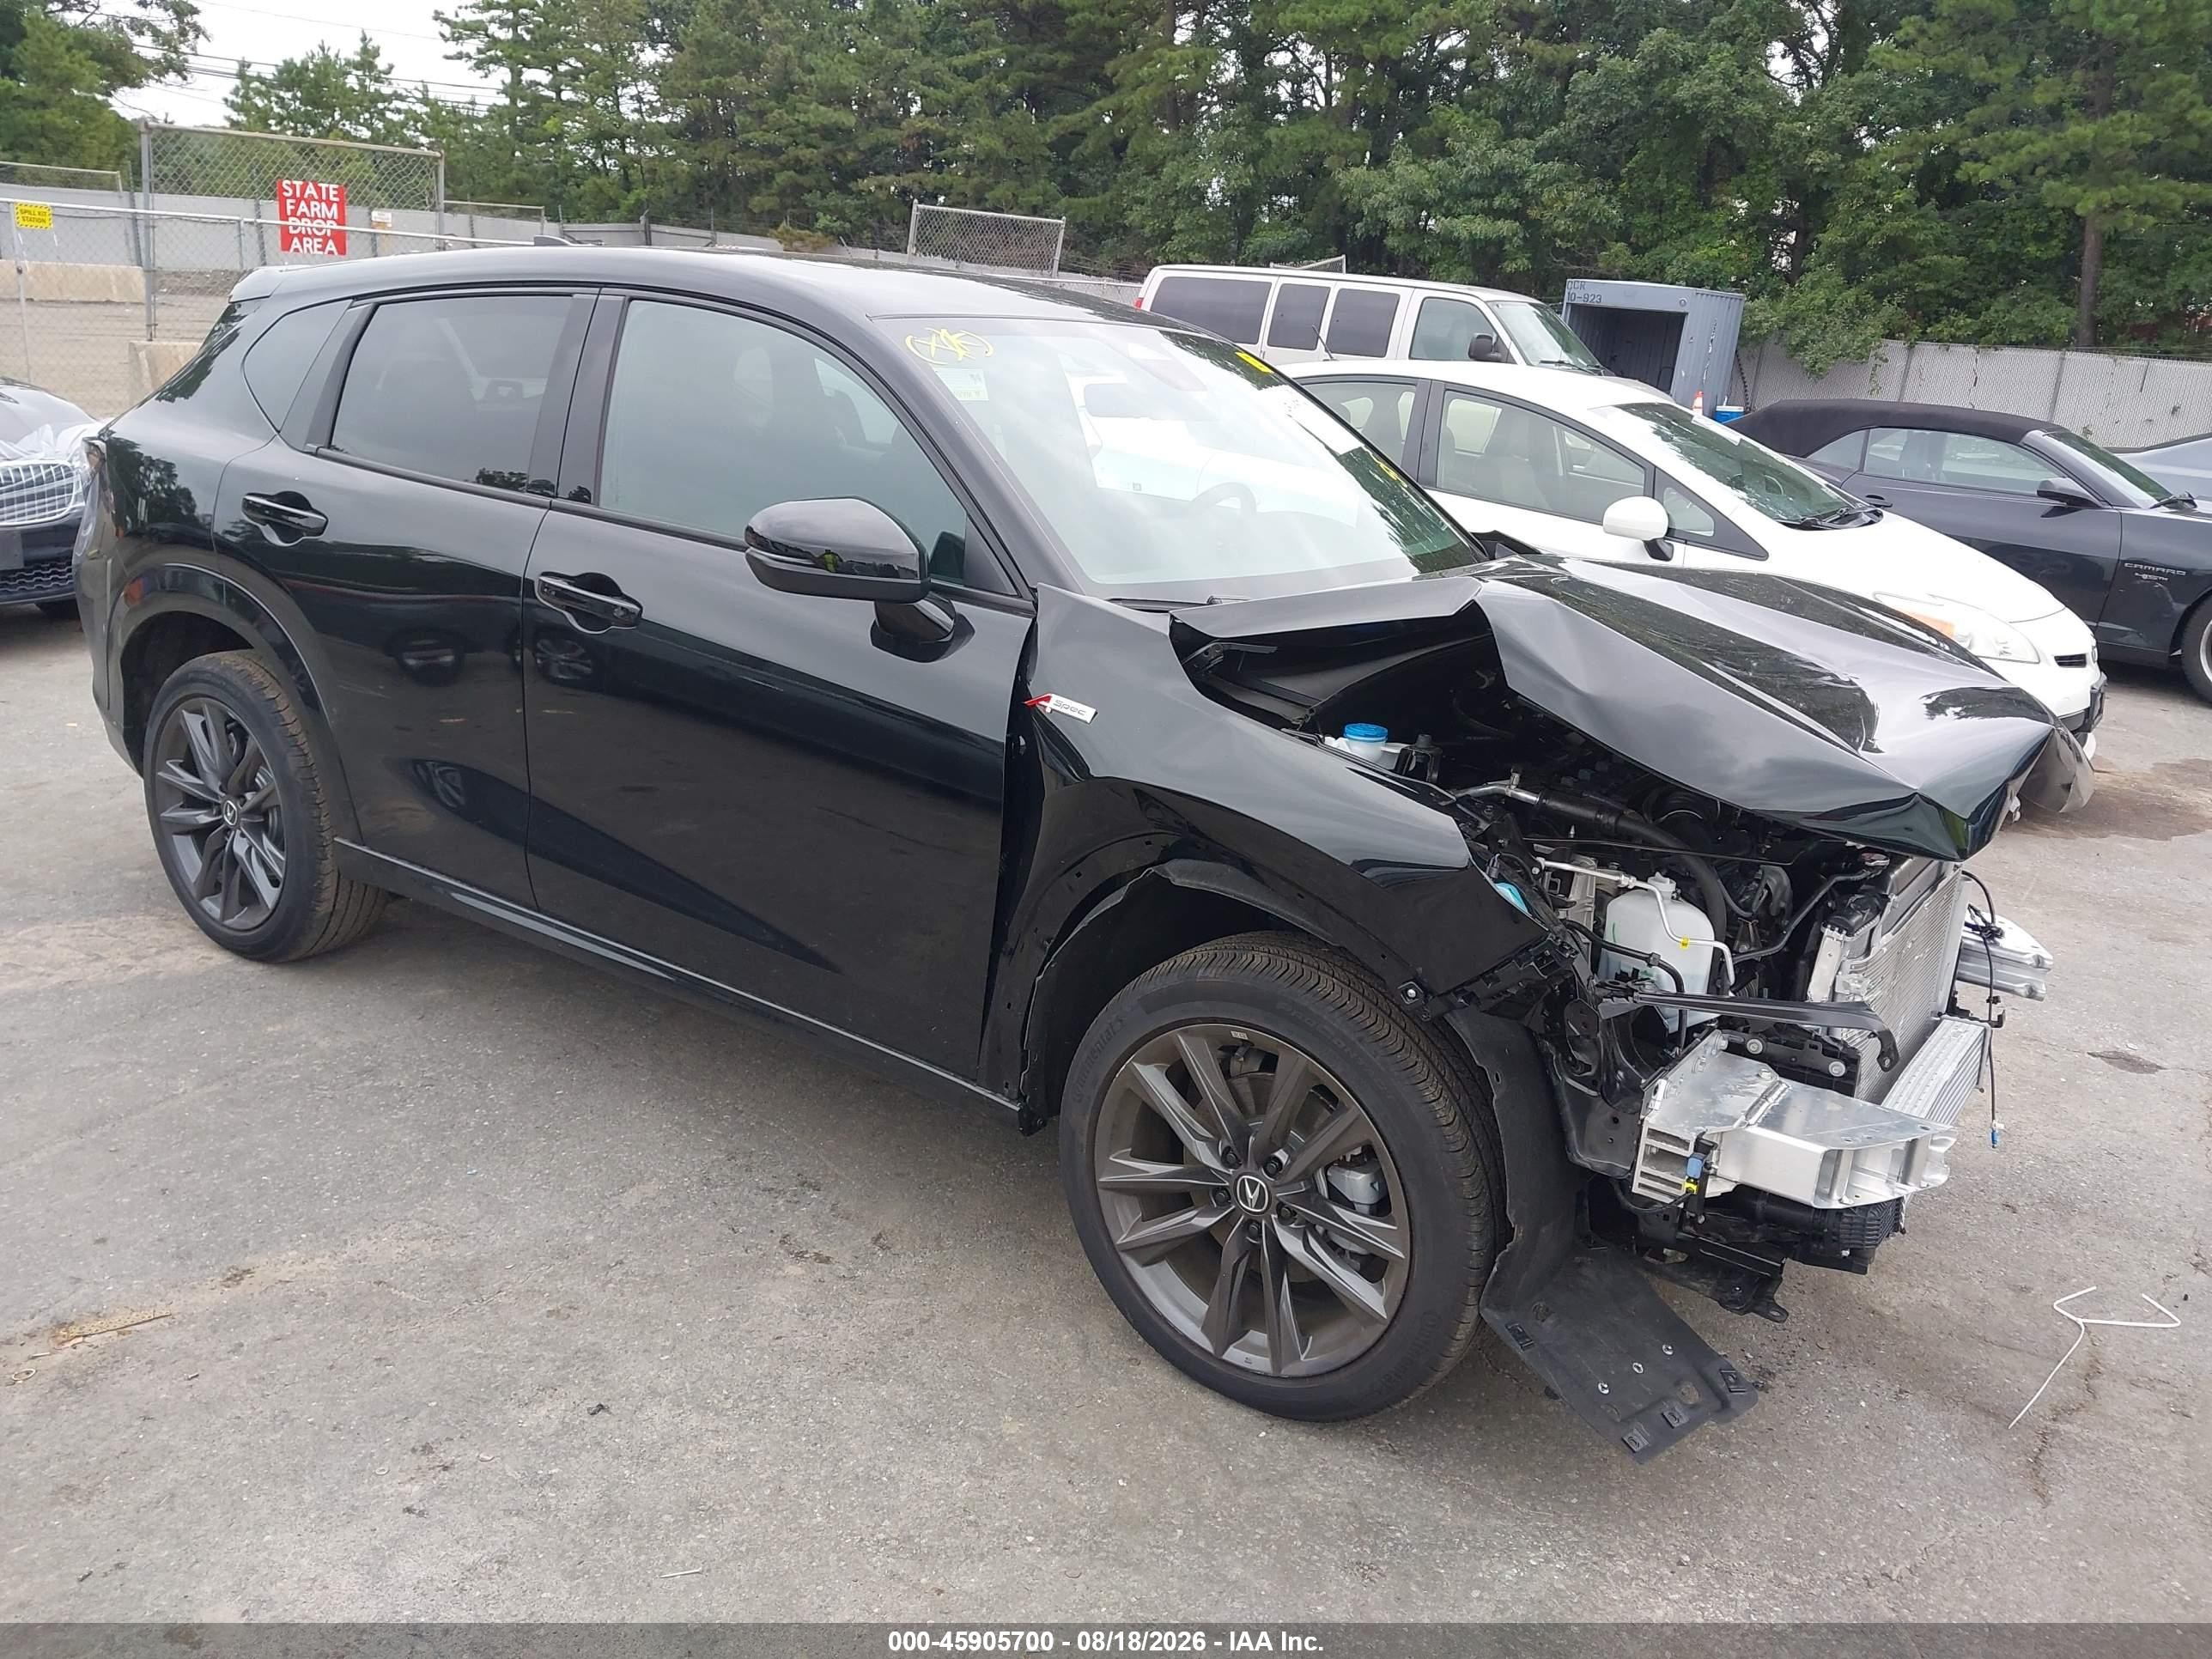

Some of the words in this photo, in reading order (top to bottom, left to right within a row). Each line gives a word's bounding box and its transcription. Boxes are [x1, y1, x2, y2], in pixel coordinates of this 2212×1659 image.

[282, 179, 340, 202] STATE
[286, 198, 338, 220] FARM
[288, 216, 337, 237] DROP
[289, 236, 338, 256] AREA
[1567, 291, 1602, 303] 10-923
[2124, 562, 2186, 576] CAMARO
